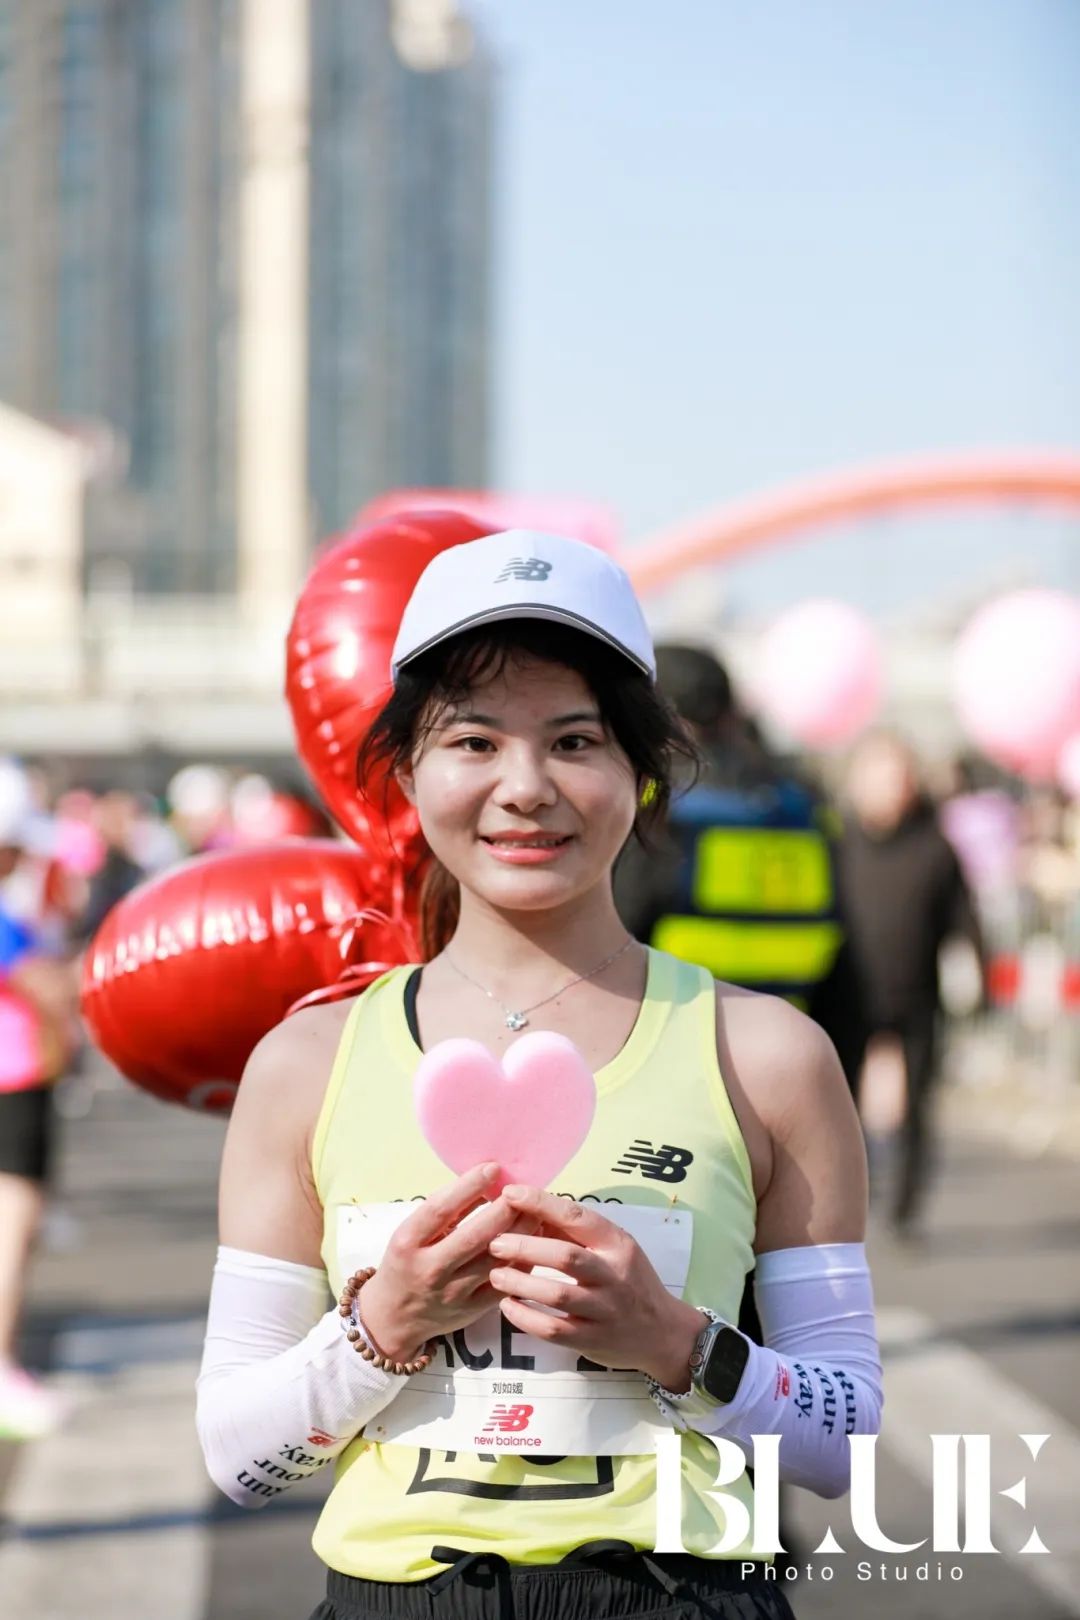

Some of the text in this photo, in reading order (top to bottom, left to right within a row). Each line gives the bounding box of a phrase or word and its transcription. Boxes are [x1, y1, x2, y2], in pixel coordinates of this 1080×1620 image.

[611, 1139, 694, 1184] NB
[474, 1436, 542, 1447] new balance
